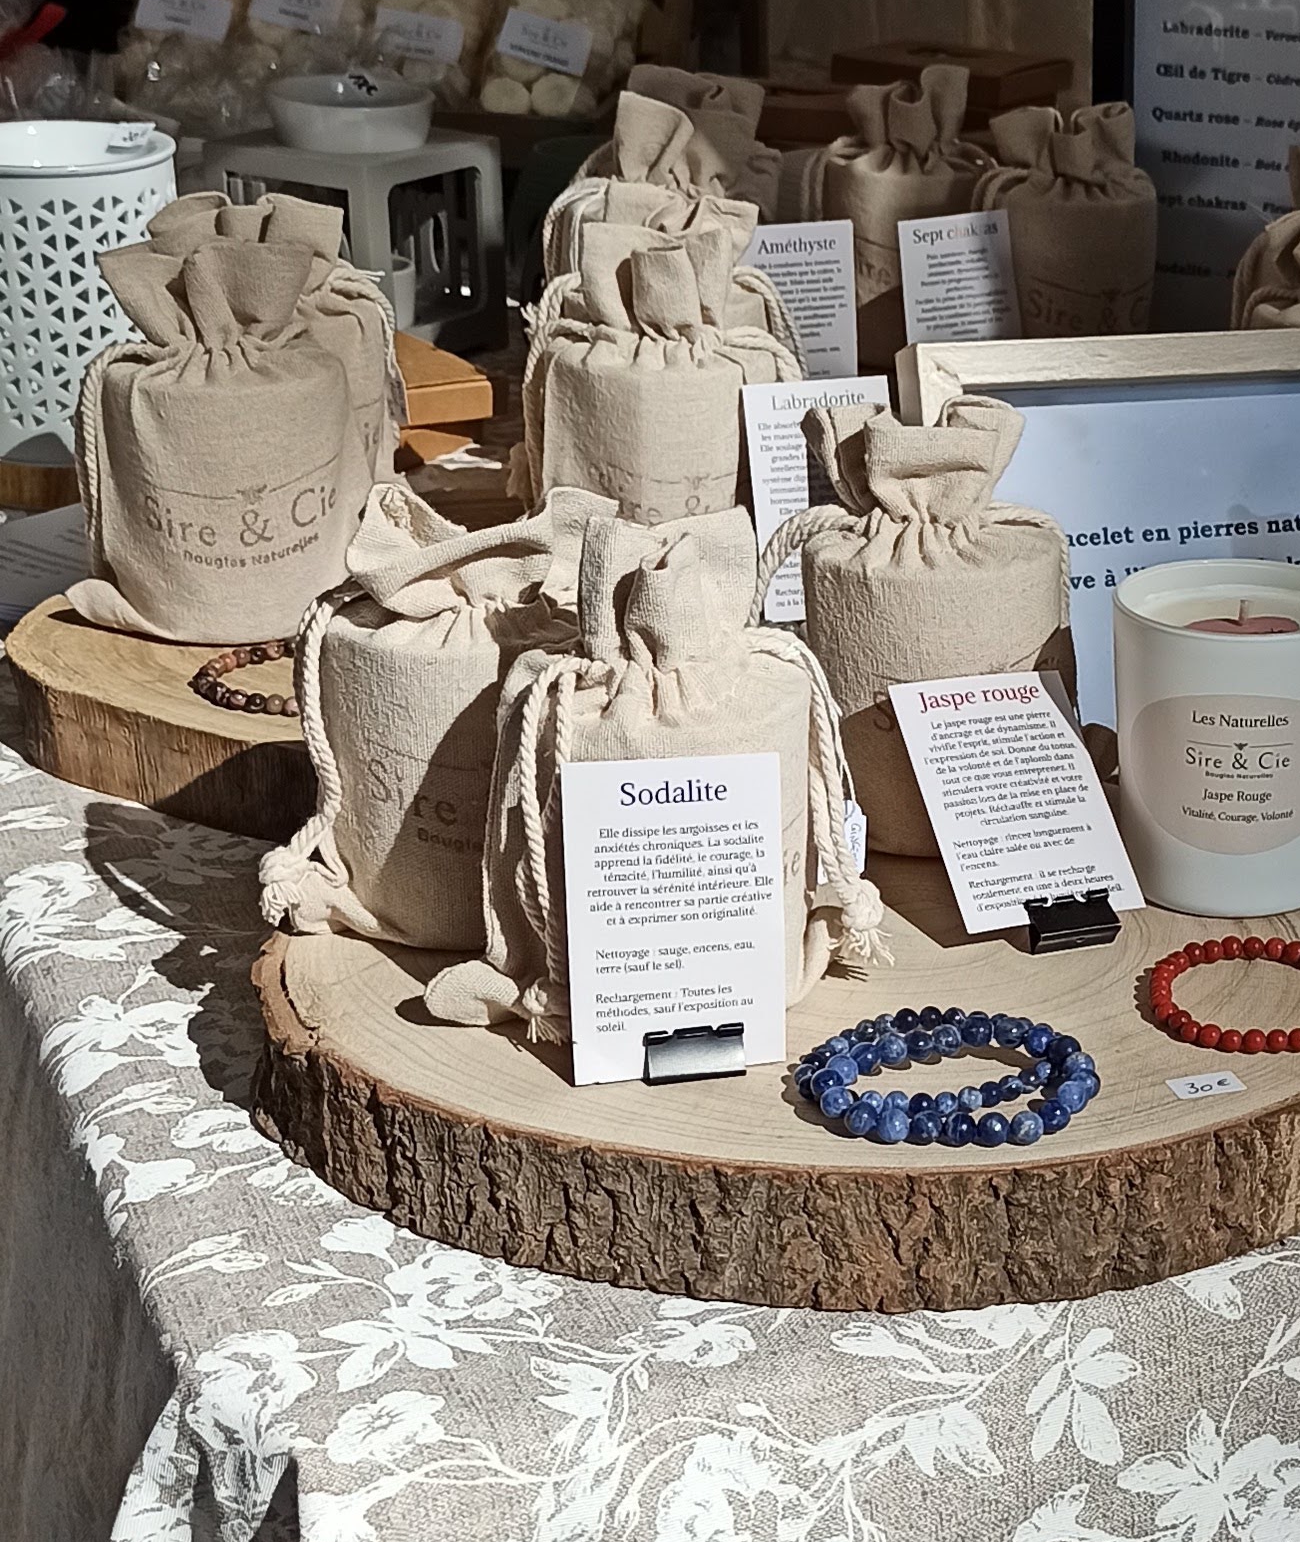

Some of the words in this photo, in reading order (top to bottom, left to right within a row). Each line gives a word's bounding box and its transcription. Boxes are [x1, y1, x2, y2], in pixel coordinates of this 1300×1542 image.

[1162, 20, 1250, 39] Labradorite
[1189, 65, 1206, 80] de
[1211, 67, 1250, 85] Tigre
[1152, 107, 1203, 123] Quartz
[1208, 112, 1240, 126] rose
[1161, 149, 1240, 169] Rhodonite
[1158, 194, 1183, 207] ept
[758, 235, 837, 256] Améthyste
[912, 227, 944, 247] Sept
[772, 390, 865, 412] Labradorite
[144, 495, 218, 547] Sire
[240, 509, 274, 547] &
[291, 485, 338, 528] Cie
[1142, 528, 1171, 543] en
[1179, 521, 1259, 545] pierres
[1104, 568, 1117, 588] à
[918, 691, 976, 713] Jaspe
[981, 684, 1040, 704] rouge
[1192, 709, 1216, 725] Les
[1219, 714, 1290, 728] Naturelles
[1185, 746, 1223, 769] Sire
[1232, 752, 1248, 770] &
[1258, 751, 1290, 769] Cie
[620, 779, 726, 806] Sodalite
[1202, 788, 1234, 803] Jaspe
[1236, 791, 1272, 803] Rouge
[1182, 805, 1216, 821] Vitalité,
[1218, 811, 1259, 825] Courage,
[1260, 808, 1294, 821] Volonté
[599, 828, 619, 838] Elle
[621, 826, 659, 838] dissipe
[662, 825, 677, 835] les
[679, 823, 729, 835] angoisses
[731, 822, 741, 831] et
[744, 819, 758, 830] les
[594, 842, 639, 853] anxiétés
[723, 834, 764, 846] sodalite
[594, 856, 640, 870] apprend
[642, 855, 652, 865] la
[697, 852, 707, 862] le
[755, 848, 765, 858] la
[707, 864, 732, 876] ainsi
[734, 862, 756, 875] qu'à
[587, 887, 637, 897] retrouver
[639, 884, 649, 894] la
[652, 881, 695, 894] sérénité
[754, 875, 773, 886] Elle
[589, 902, 612, 912] aide
[615, 901, 621, 911] à
[624, 899, 681, 910] rencontrer
[683, 898, 695, 906] sa
[697, 893, 728, 907] partie
[730, 890, 772, 903] créative
[606, 917, 616, 926] et
[618, 915, 625, 925] à
[627, 913, 678, 926] exprimer
[680, 912, 699, 921] son
[595, 949, 649, 960] Nettoyage
[658, 946, 691, 956] sauge,
[692, 943, 731, 953] encens,
[733, 941, 755, 950] eau,
[623, 961, 650, 973] (sauf
[652, 960, 662, 970] le
[664, 958, 684, 969] sel).
[595, 991, 671, 1003] Rechargement
[679, 987, 715, 997] Toutes
[717, 984, 732, 994] les
[595, 1006, 650, 1018] méthodes,
[653, 1002, 676, 1014] sauf
[678, 998, 738, 1012] l'exposition
[740, 997, 753, 1005] au
